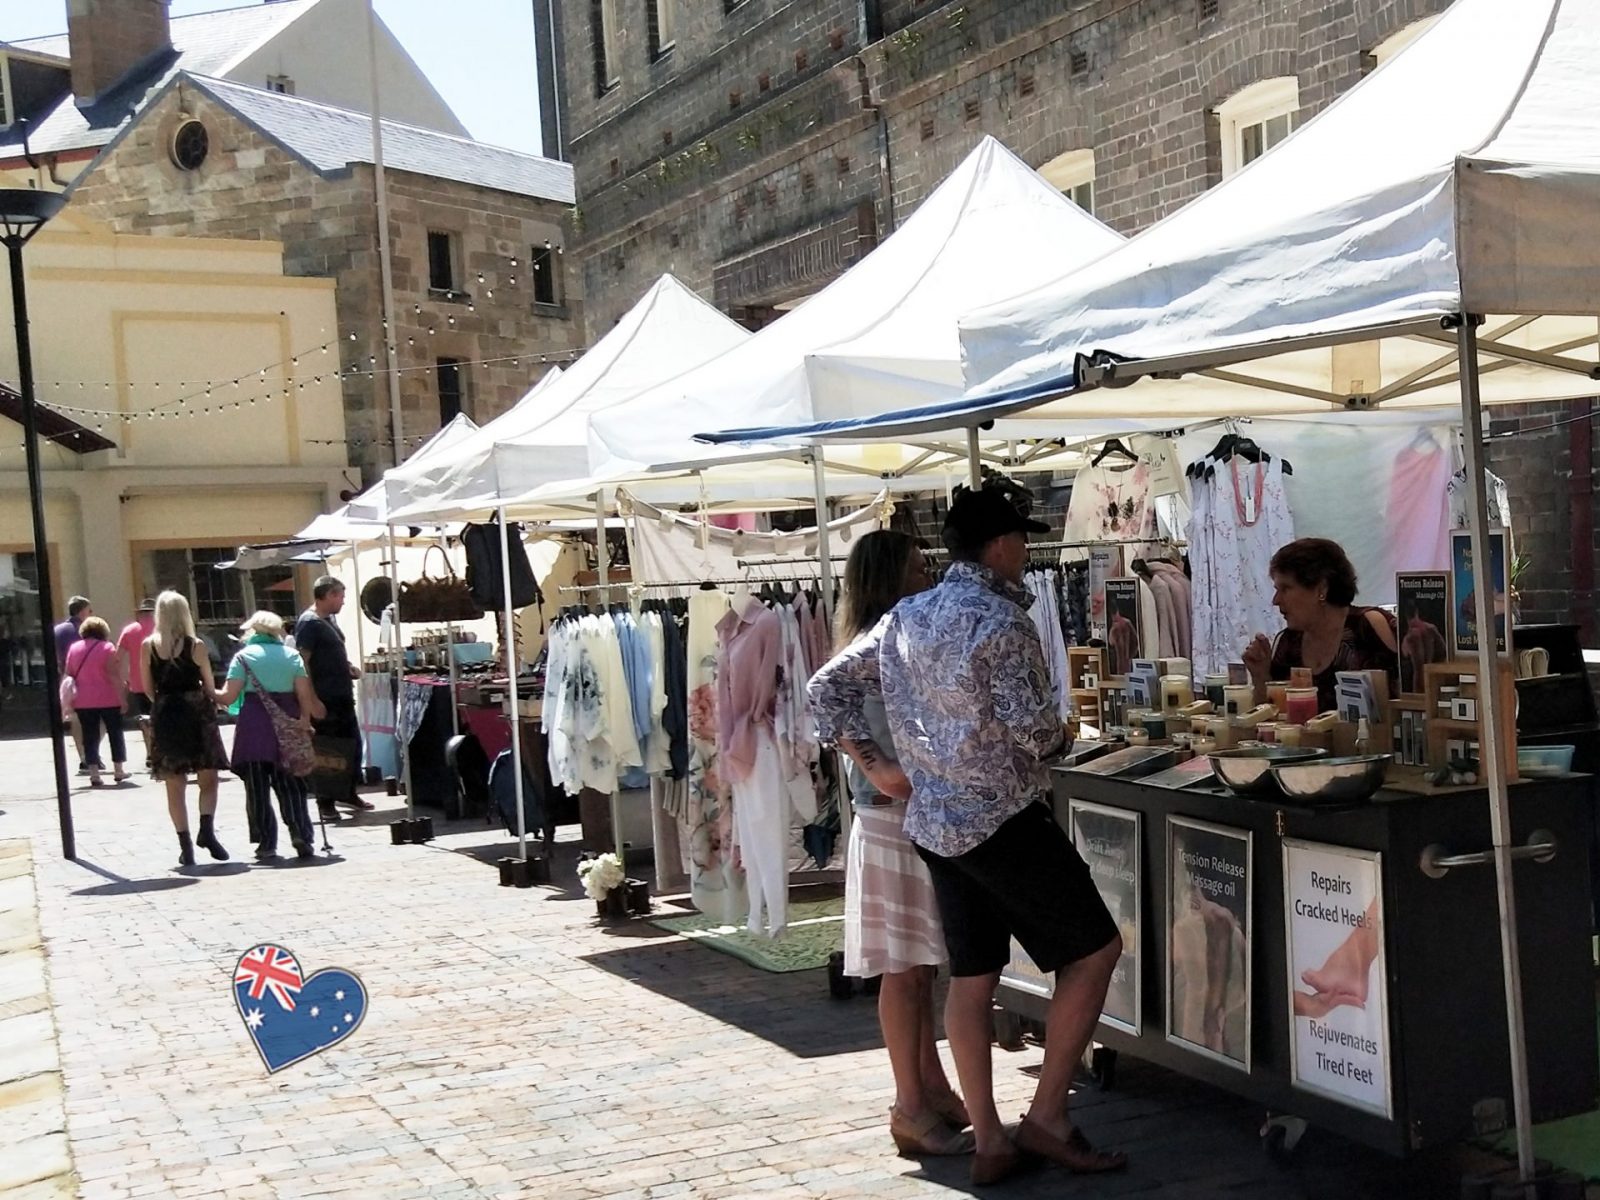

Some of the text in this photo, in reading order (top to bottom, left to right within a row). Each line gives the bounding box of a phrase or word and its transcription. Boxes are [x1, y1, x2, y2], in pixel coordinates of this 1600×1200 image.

[1400, 579, 1444, 589] Tension Release
[1178, 848, 1245, 879] Tension Release
[1187, 871, 1236, 897] Massage oil
[1311, 871, 1352, 895] Repairs
[1295, 899, 1372, 930] Cracked Heels
[1309, 1019, 1378, 1055] Rejuvenates
[1315, 1051, 1373, 1085] Tired Feet
